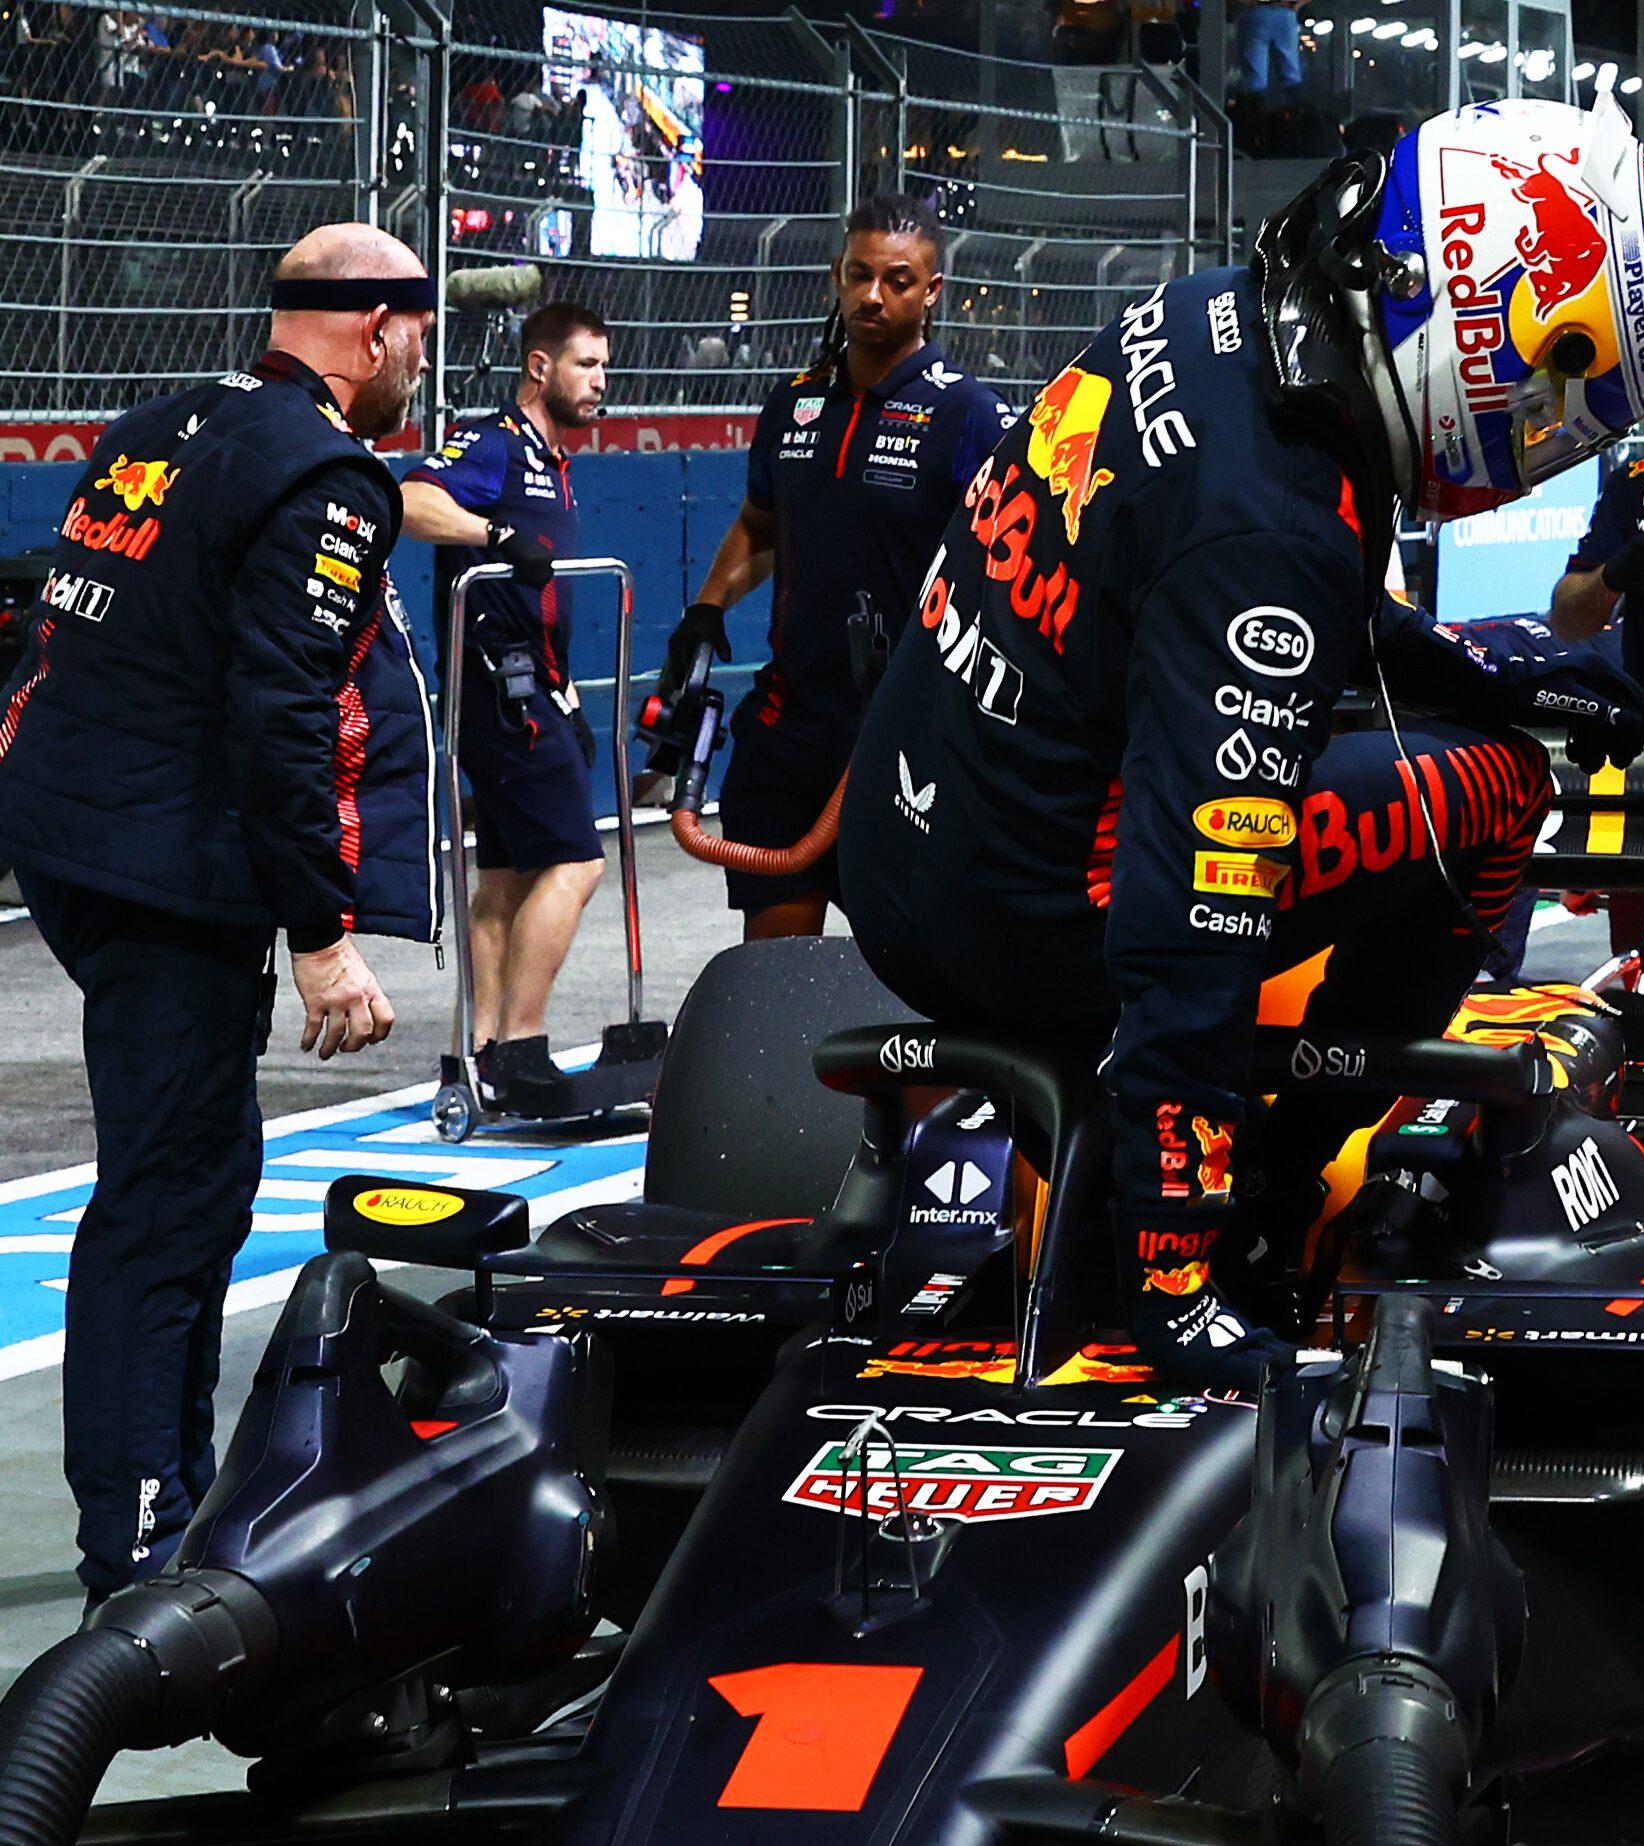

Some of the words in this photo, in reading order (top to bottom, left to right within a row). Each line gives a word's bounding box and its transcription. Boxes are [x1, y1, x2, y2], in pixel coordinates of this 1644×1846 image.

[876, 435, 920, 453] BYBIT
[868, 454, 918, 468] HONDA
[327, 502, 376, 543] Mobil
[1453, 506, 1587, 547] COMMUNICATIONS
[86, 586, 102, 615] 1
[1243, 620, 1304, 658] Esso
[982, 656, 1006, 709] 1
[1535, 689, 1598, 715] sparco
[1258, 747, 1302, 787] Sui
[1227, 812, 1290, 835] RAUCH
[1189, 905, 1252, 937] Cash
[904, 1039, 936, 1069] Sui
[1326, 1047, 1365, 1077] Sui
[381, 1195, 449, 1213] RAUCH
[910, 1205, 997, 1225] inter.mx
[594, 1310, 766, 1324] Walmart
[806, 1404, 1198, 1428] ORACLE
[857, 1449, 1089, 1475] TAG
[808, 1479, 1081, 1511] HEUER
[708, 1662, 923, 1812] 1
